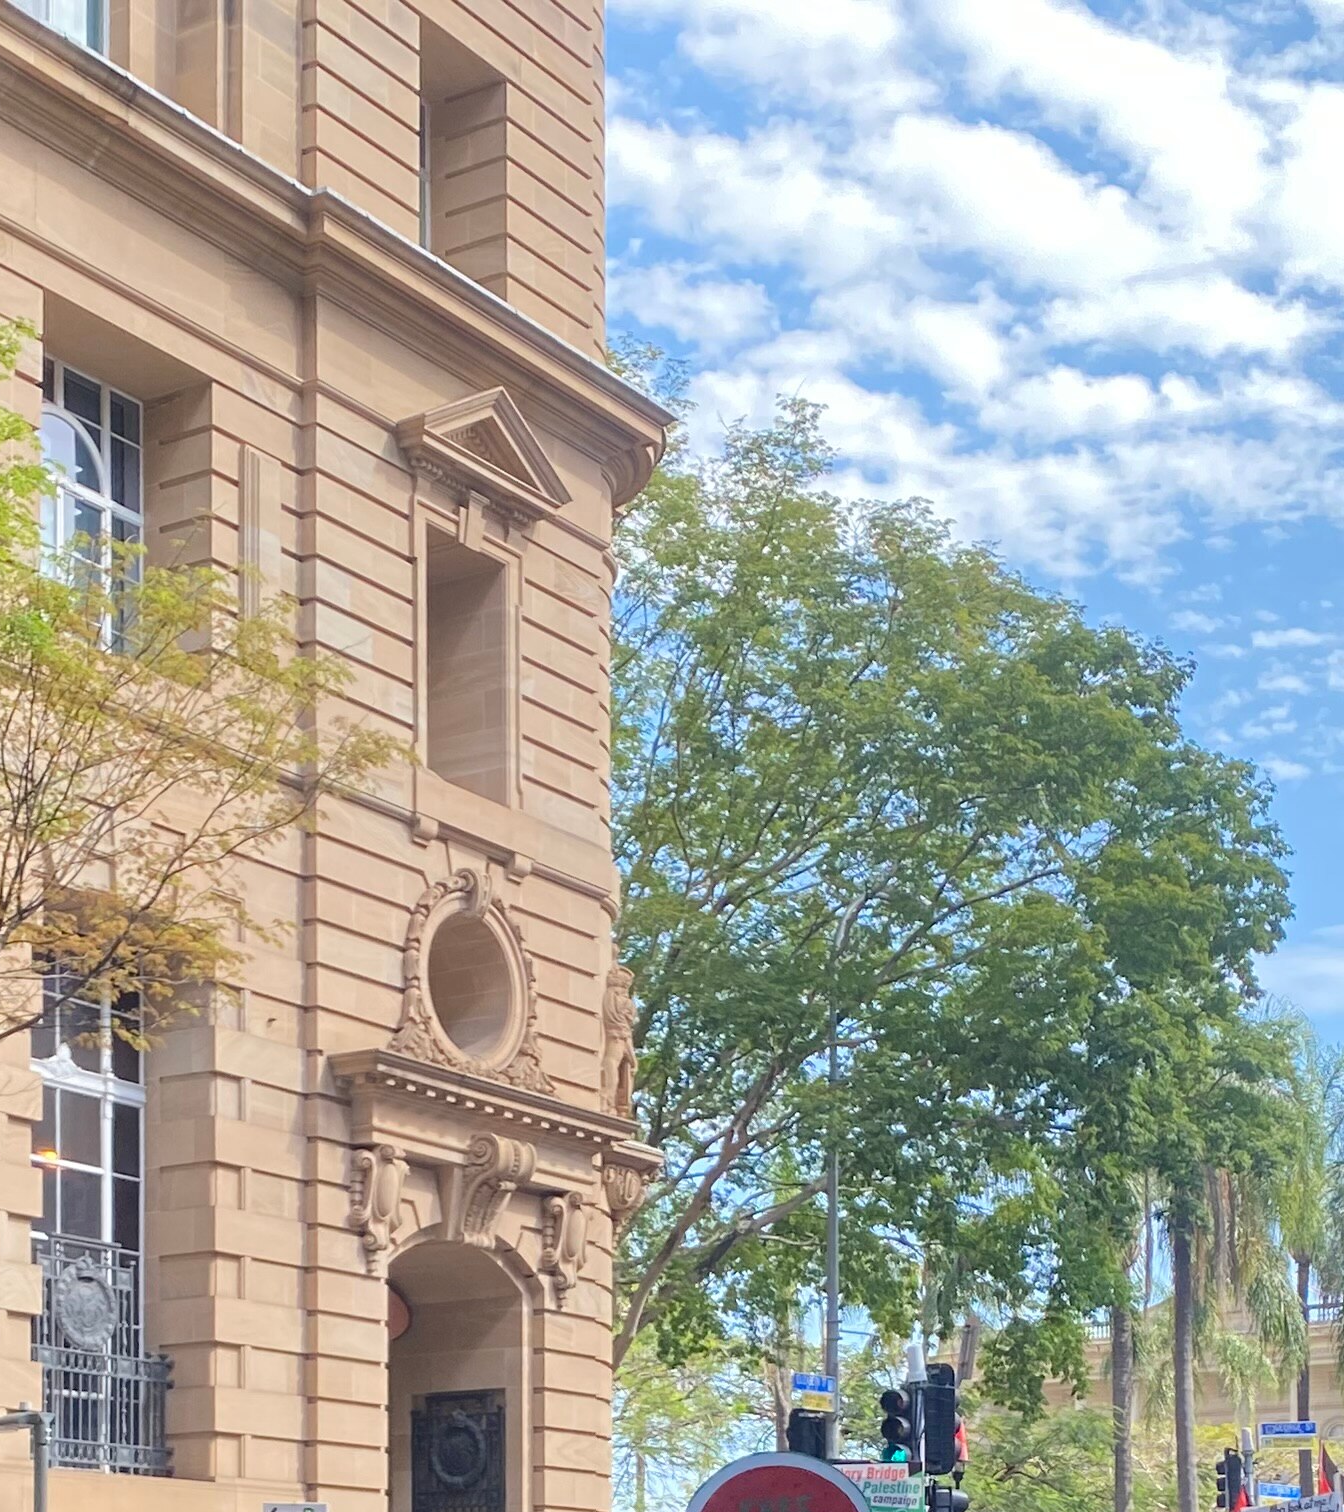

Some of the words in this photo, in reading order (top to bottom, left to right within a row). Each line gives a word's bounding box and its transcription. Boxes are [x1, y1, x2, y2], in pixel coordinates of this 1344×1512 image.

[867, 1467, 906, 1482] Bridge
[863, 1481, 920, 1494] Palestine
[873, 1495, 917, 1506] campaign
